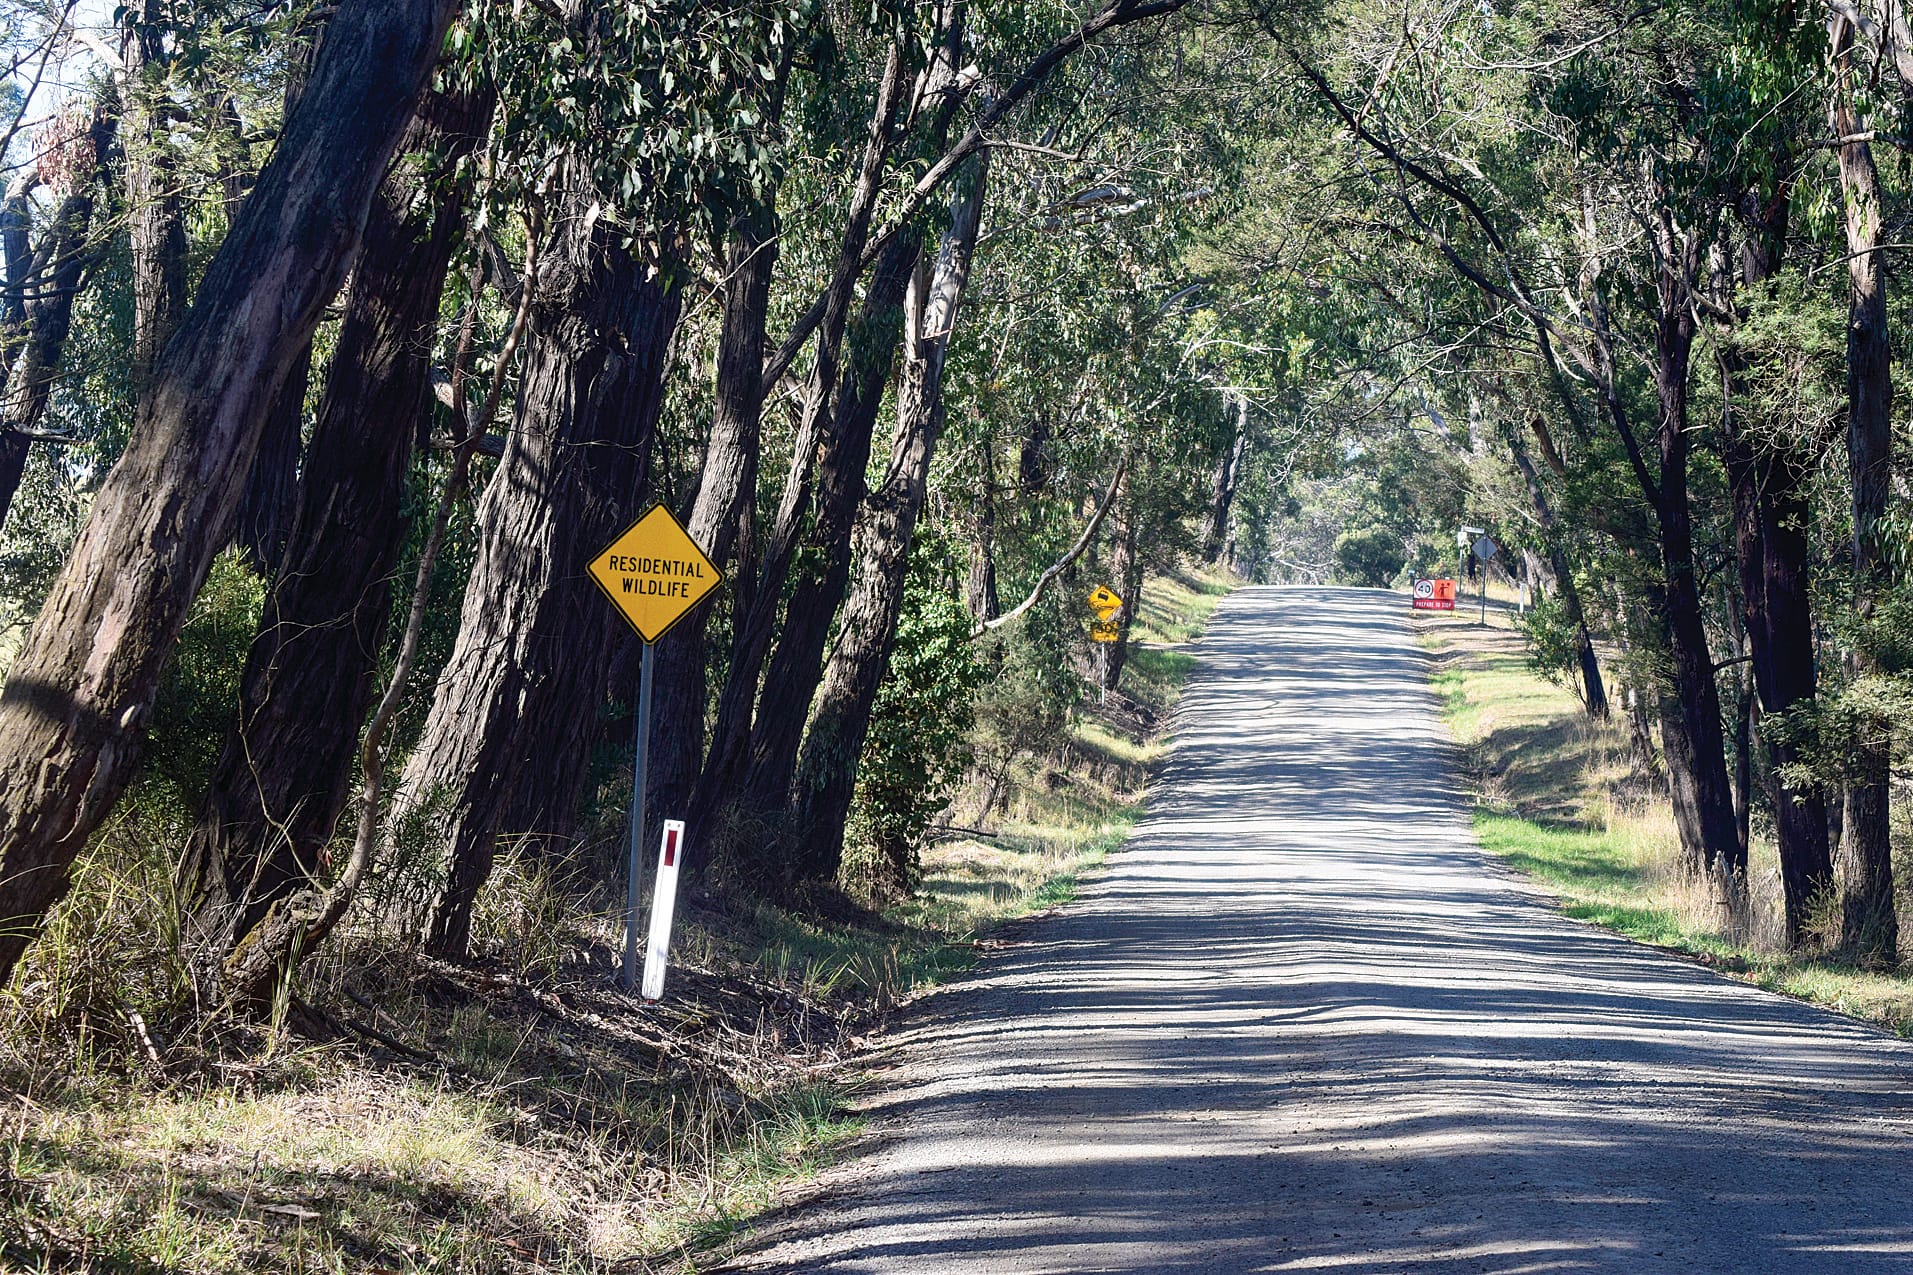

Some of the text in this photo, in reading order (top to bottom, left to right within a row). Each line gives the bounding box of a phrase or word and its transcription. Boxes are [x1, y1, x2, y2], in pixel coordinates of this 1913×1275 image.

[609, 555, 704, 578] RESIDENTIAL
[622, 578, 690, 598] WILDLIFE
[1418, 585, 1431, 593] 40
